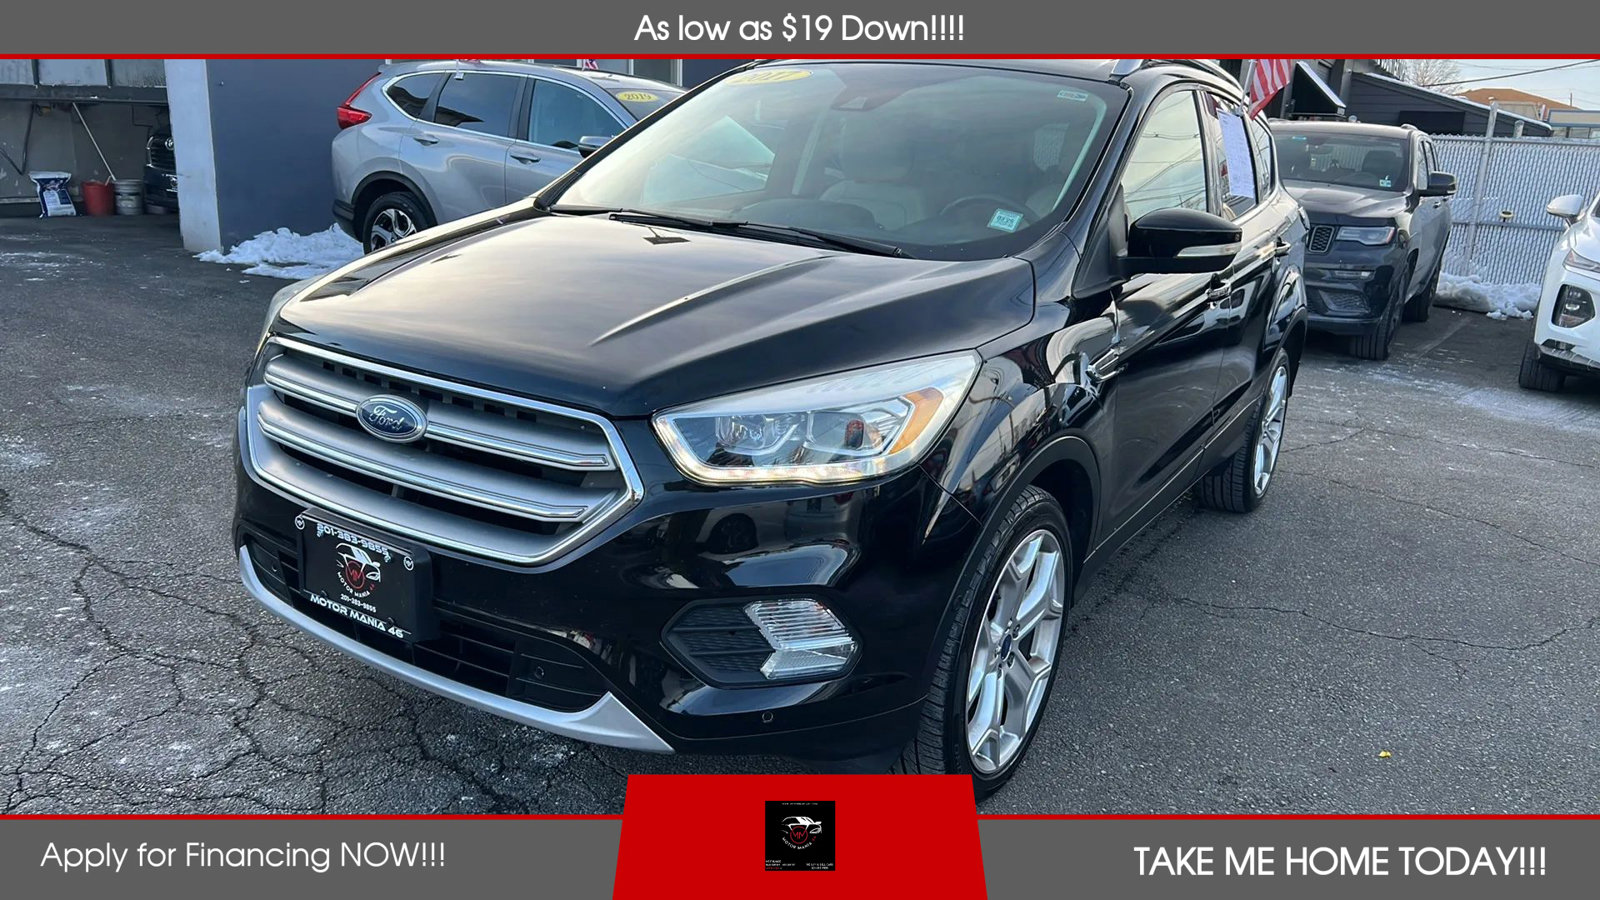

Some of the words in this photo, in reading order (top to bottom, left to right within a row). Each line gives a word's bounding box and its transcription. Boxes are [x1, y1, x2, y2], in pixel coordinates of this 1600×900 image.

[368, 405, 405, 431] Ford
[310, 594, 348, 616] MOTOR
[349, 610, 386, 632] MANIA
[388, 625, 405, 639] 46
